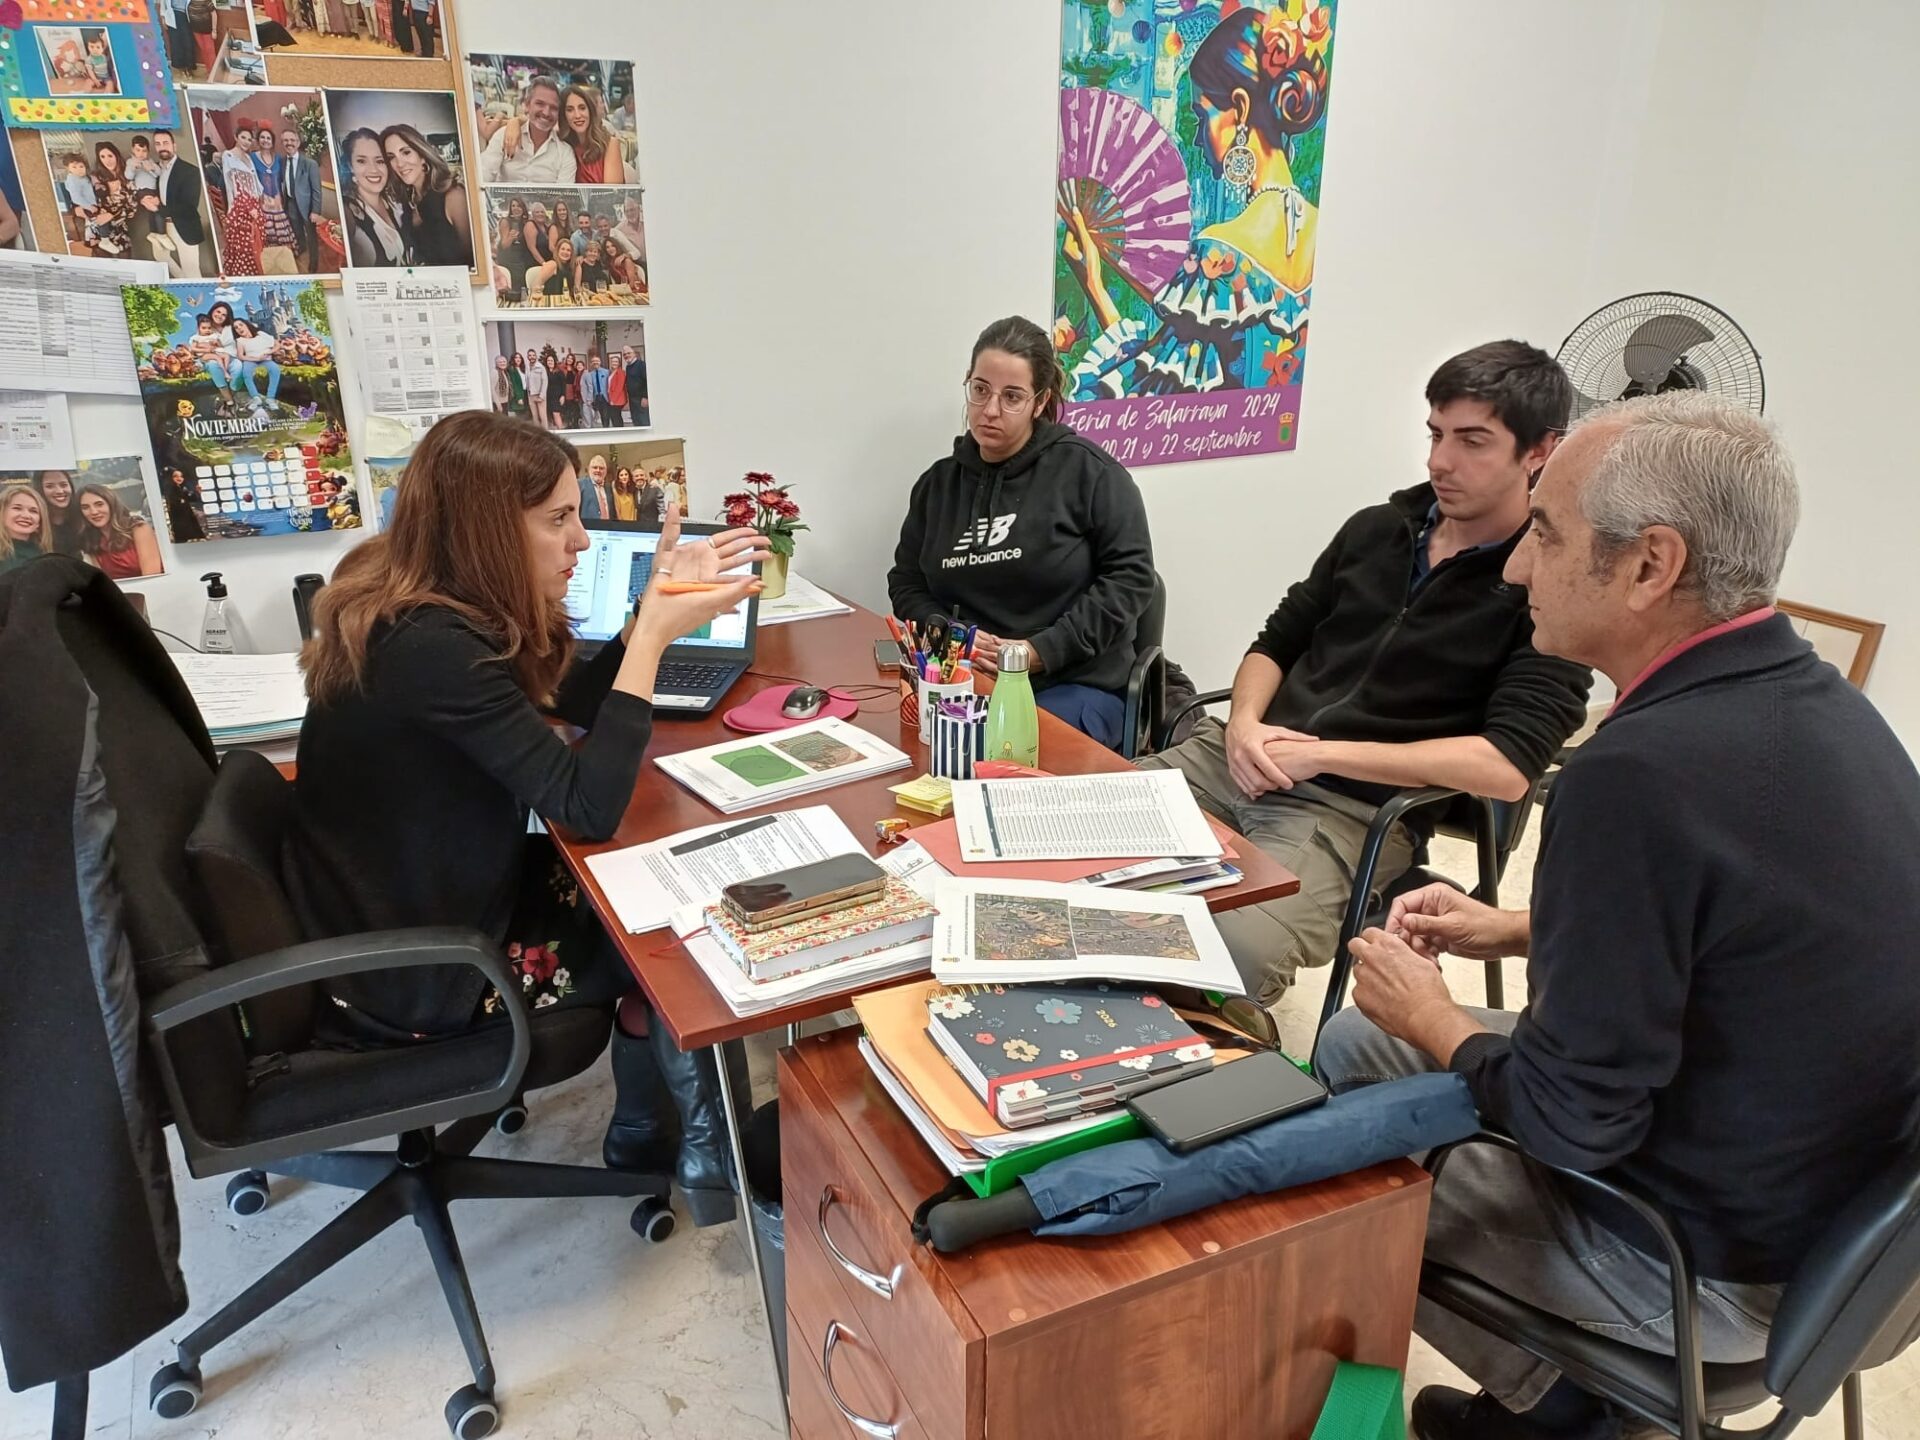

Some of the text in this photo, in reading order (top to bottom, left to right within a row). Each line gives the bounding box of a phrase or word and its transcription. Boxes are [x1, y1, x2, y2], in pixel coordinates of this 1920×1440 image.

[1067, 393, 1281, 432] Feria de Zafarraya 2024
[1142, 441, 1154, 459] y
[1159, 433, 1179, 456] 22
[1183, 425, 1263, 457] septiembre
[942, 547, 1022, 569] new balance
